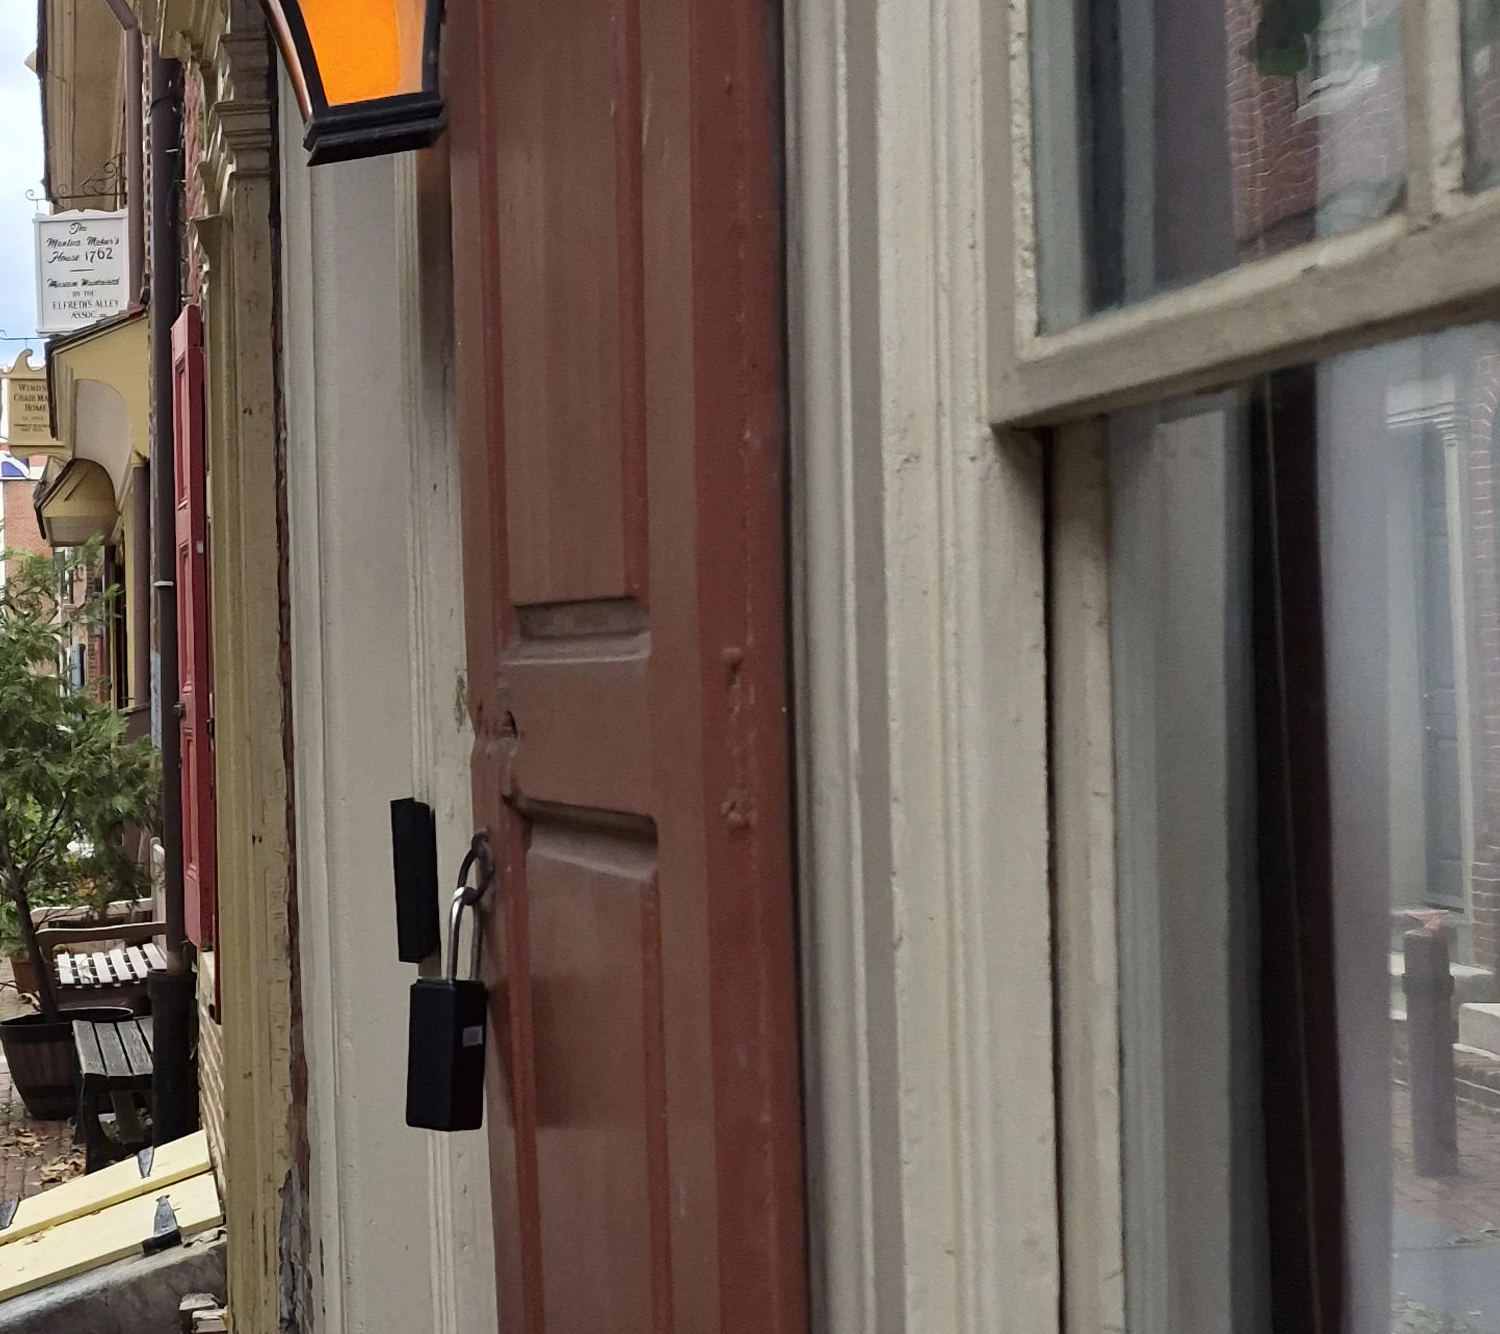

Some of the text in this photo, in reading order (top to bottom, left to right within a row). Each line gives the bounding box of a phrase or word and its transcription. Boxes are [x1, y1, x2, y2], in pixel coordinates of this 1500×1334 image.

[47, 247, 113, 264] House 1762
[95, 299, 119, 307] ALLEY
